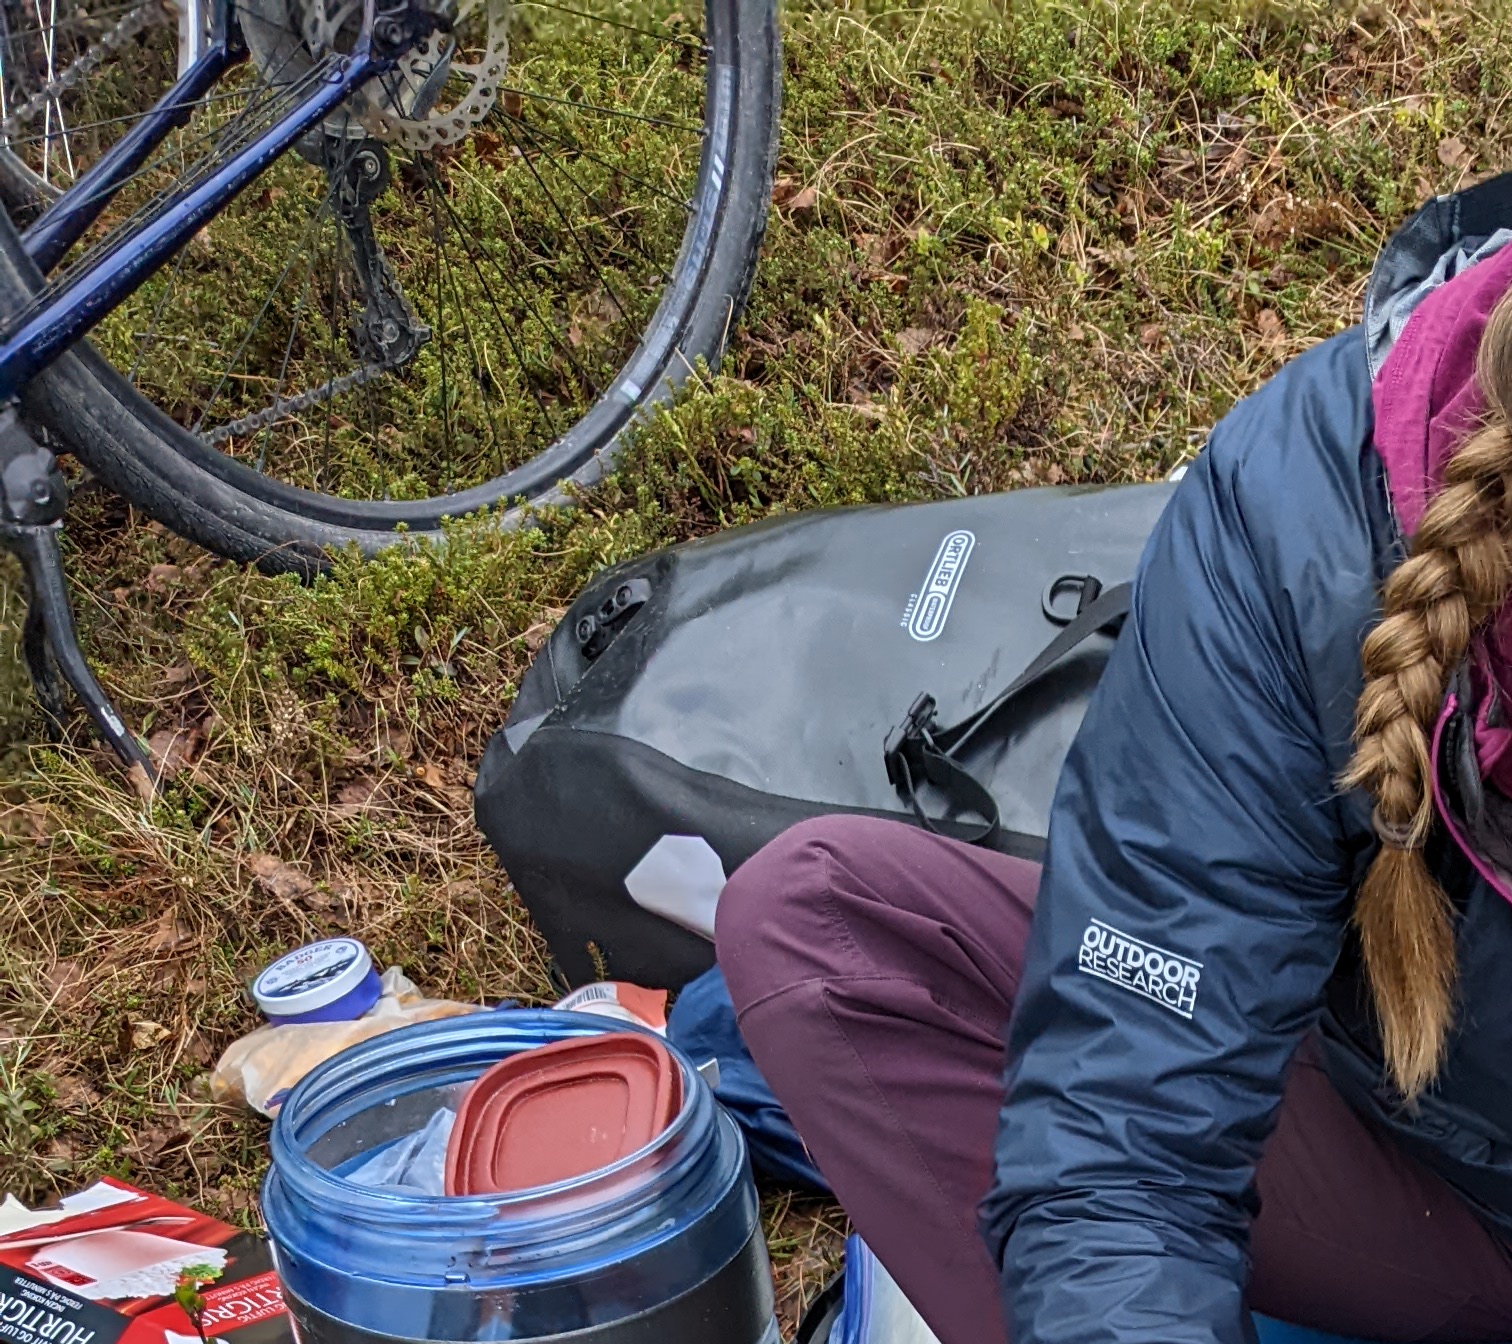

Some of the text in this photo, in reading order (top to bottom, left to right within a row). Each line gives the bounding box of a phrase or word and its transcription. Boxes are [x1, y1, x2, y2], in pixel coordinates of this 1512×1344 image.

[935, 537, 966, 587] ORTLIEB
[1078, 944, 1197, 1012] RESEARCH
[1083, 925, 1201, 991] OUTDOOR
[0, 1321, 19, 1337] LUF
[17, 1330, 33, 1343] OG
